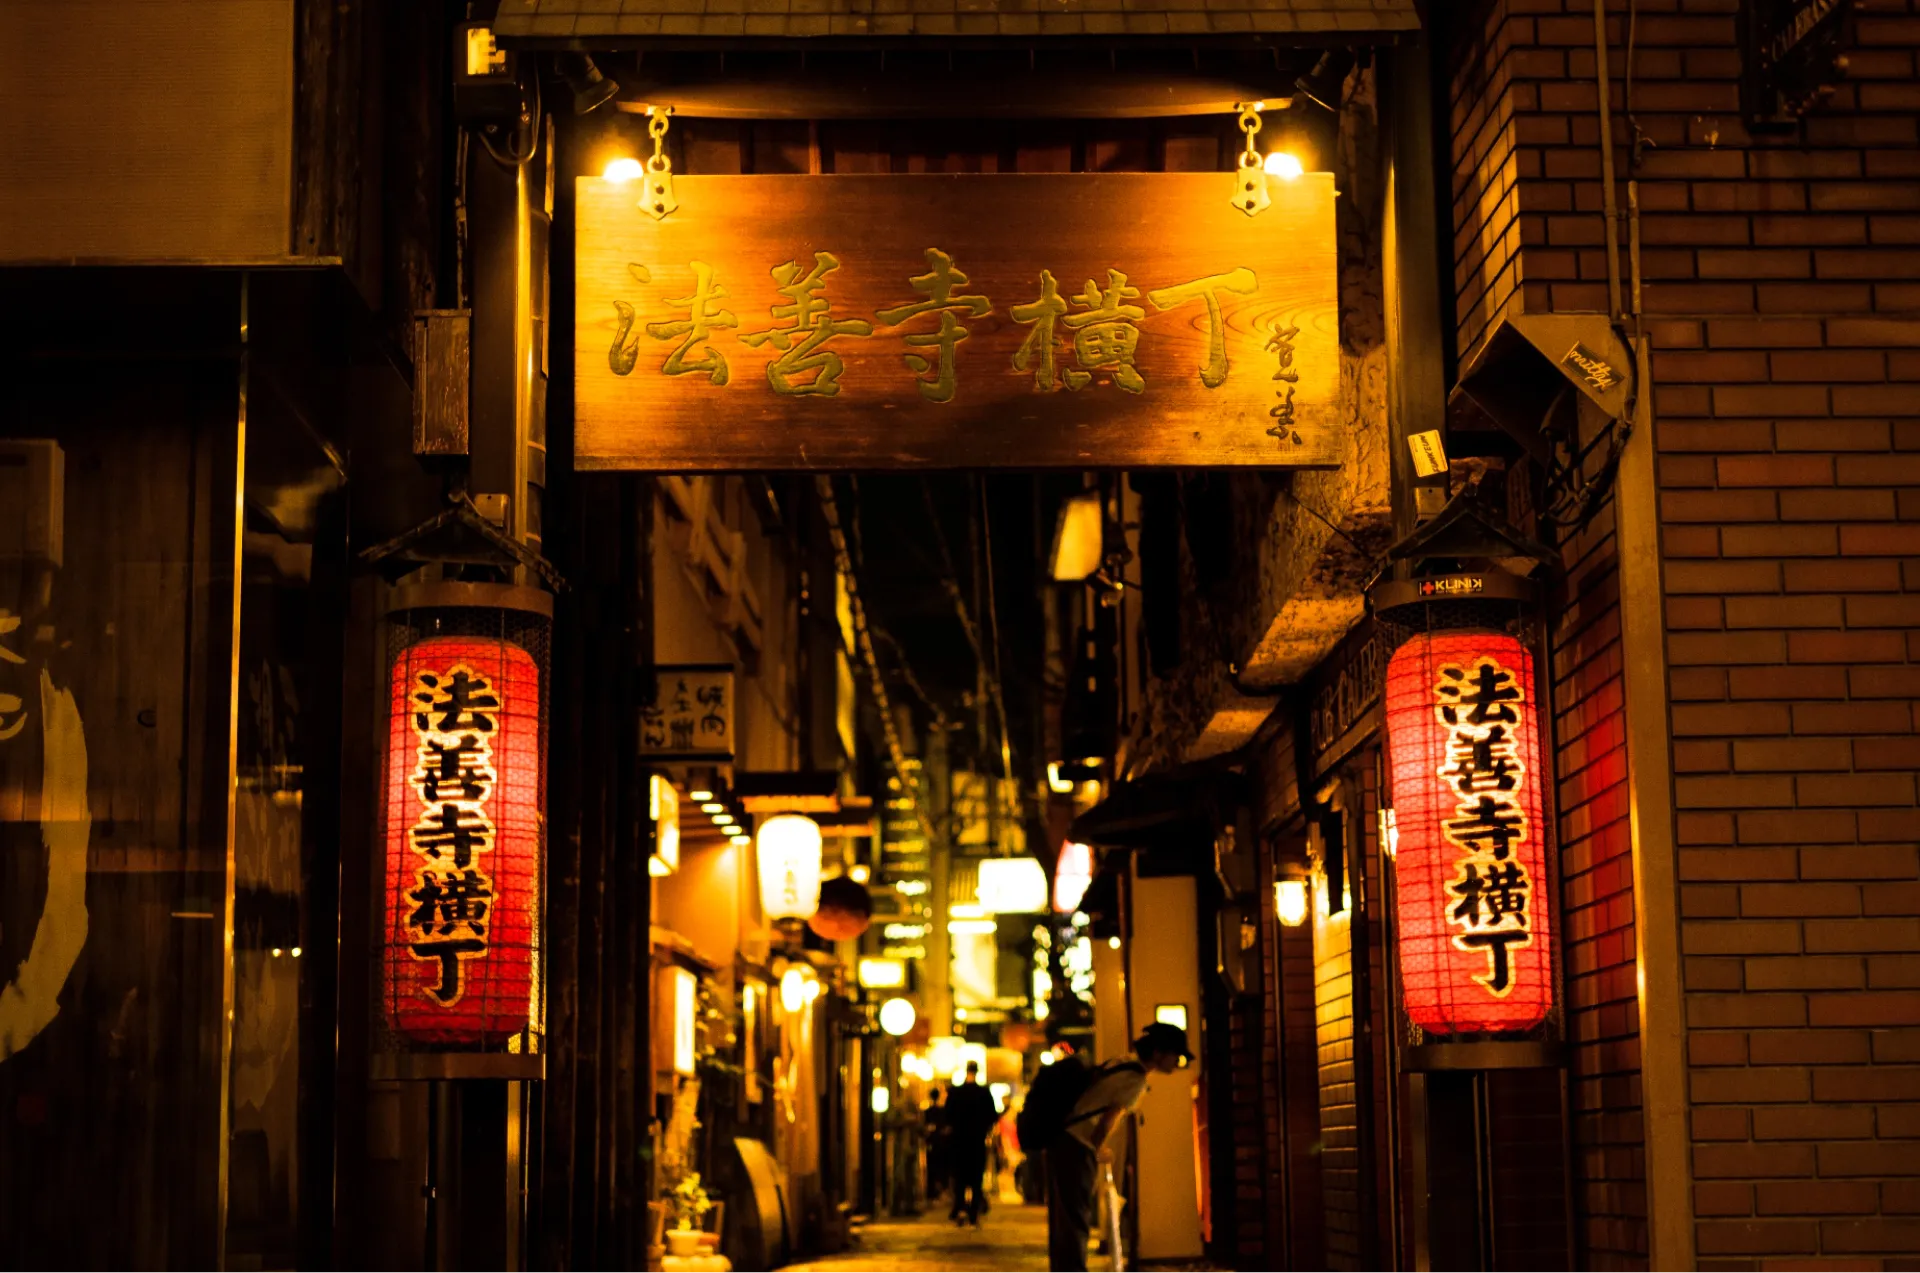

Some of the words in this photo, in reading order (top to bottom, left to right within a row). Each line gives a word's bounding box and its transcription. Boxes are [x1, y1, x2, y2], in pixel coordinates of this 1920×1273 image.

[607, 247, 1259, 403] 法善寺横丁
[409, 669, 499, 1003] 法善寺横丁
[1437, 662, 1530, 993] 法善寺横丁
